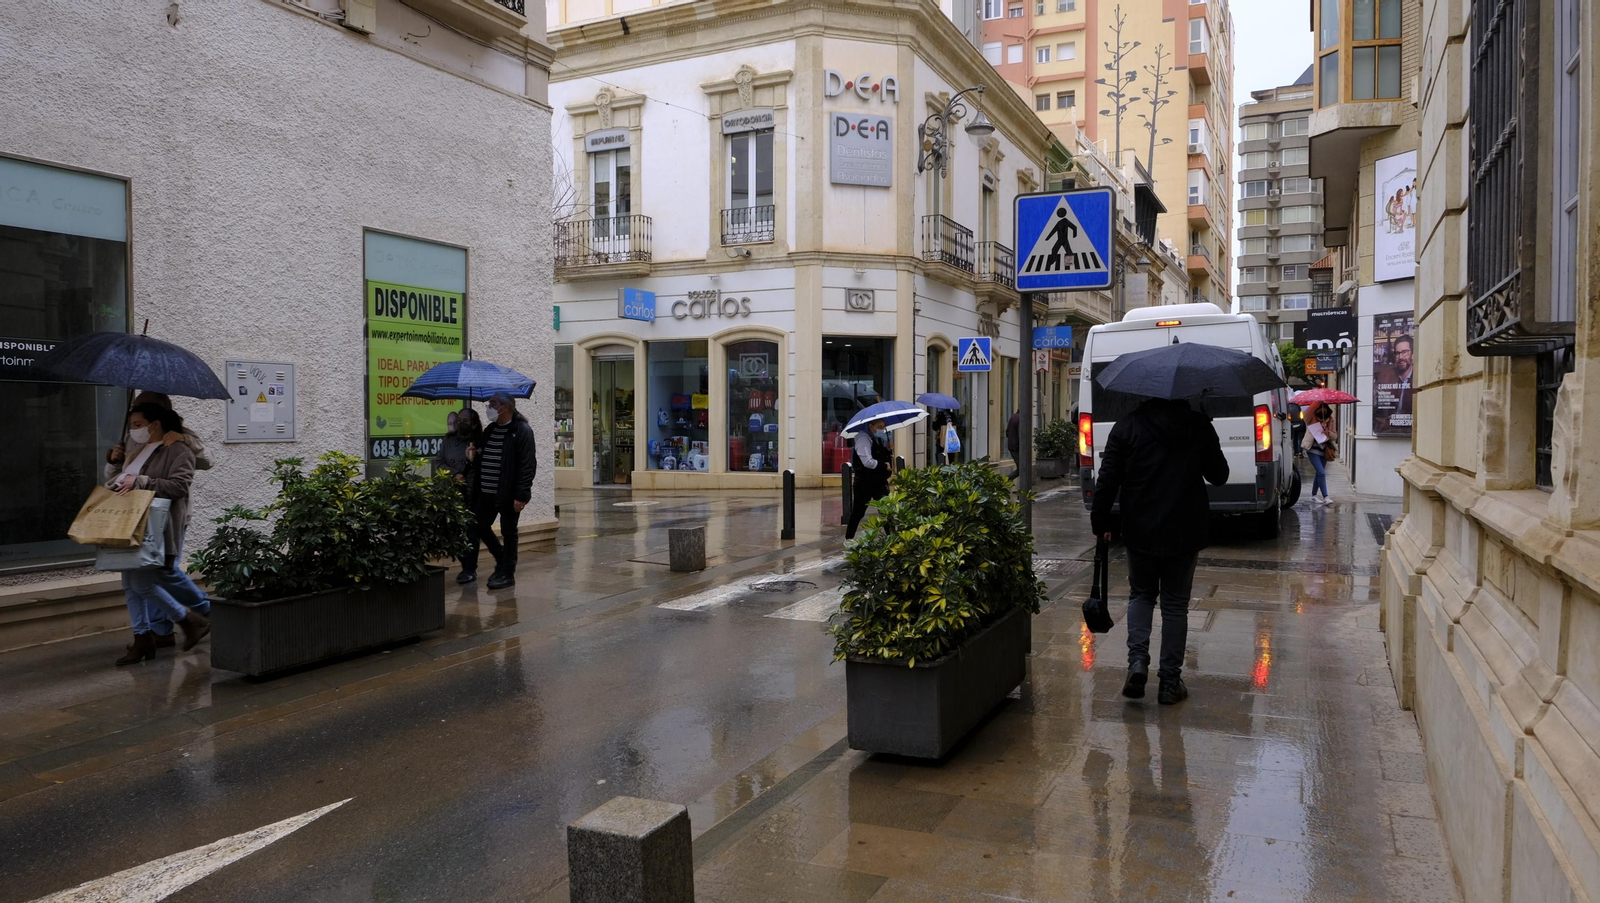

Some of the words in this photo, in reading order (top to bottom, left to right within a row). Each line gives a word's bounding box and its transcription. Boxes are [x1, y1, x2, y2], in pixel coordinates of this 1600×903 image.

[837, 144, 887, 159] Dentistas
[837, 170, 887, 183] Asociados
[375, 287, 457, 324] DISPONIBLE
[624, 303, 655, 319] carlos
[671, 289, 750, 319] carlos
[371, 329, 460, 346] www.expertoinmobiliario.com
[1034, 336, 1070, 347] carlos
[378, 358, 404, 371] IDEAL
[407, 360, 430, 372] PARA
[378, 376, 400, 388] TIPO
[402, 376, 414, 388] DE
[373, 440, 395, 457] 685
[415, 439, 429, 455] 20
